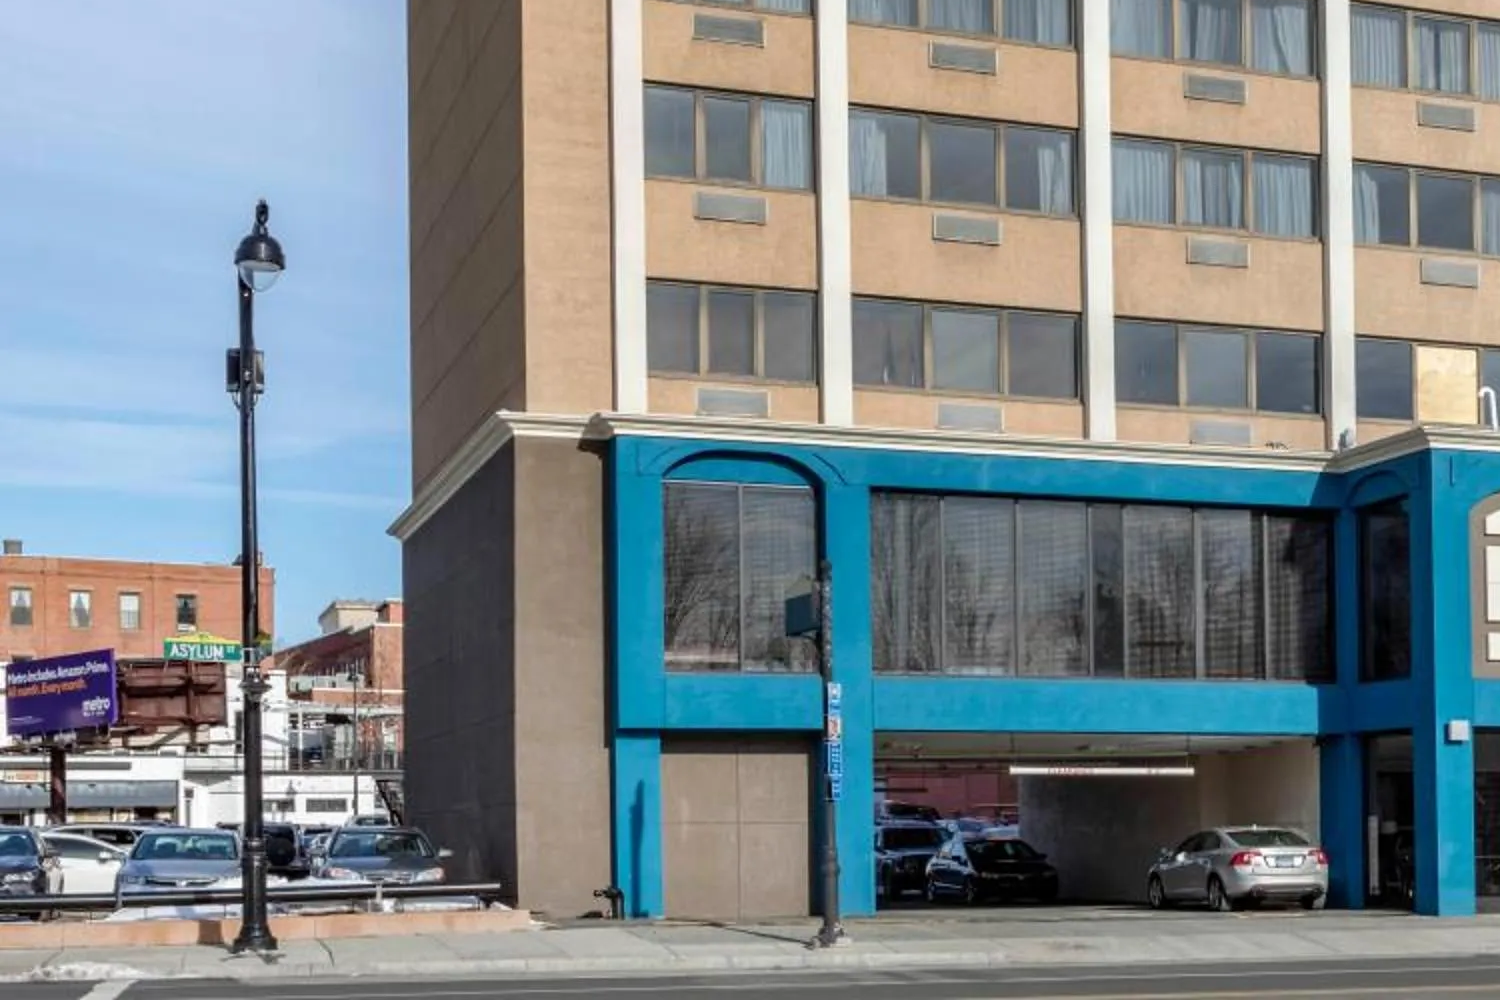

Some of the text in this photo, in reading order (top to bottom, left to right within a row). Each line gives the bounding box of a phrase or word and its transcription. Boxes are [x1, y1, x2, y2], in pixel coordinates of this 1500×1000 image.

[170, 643, 224, 659] ASYLUM
[8, 673, 27, 684] Metro
[58, 666, 88, 677] Amazon
[82, 696, 111, 711] metro
